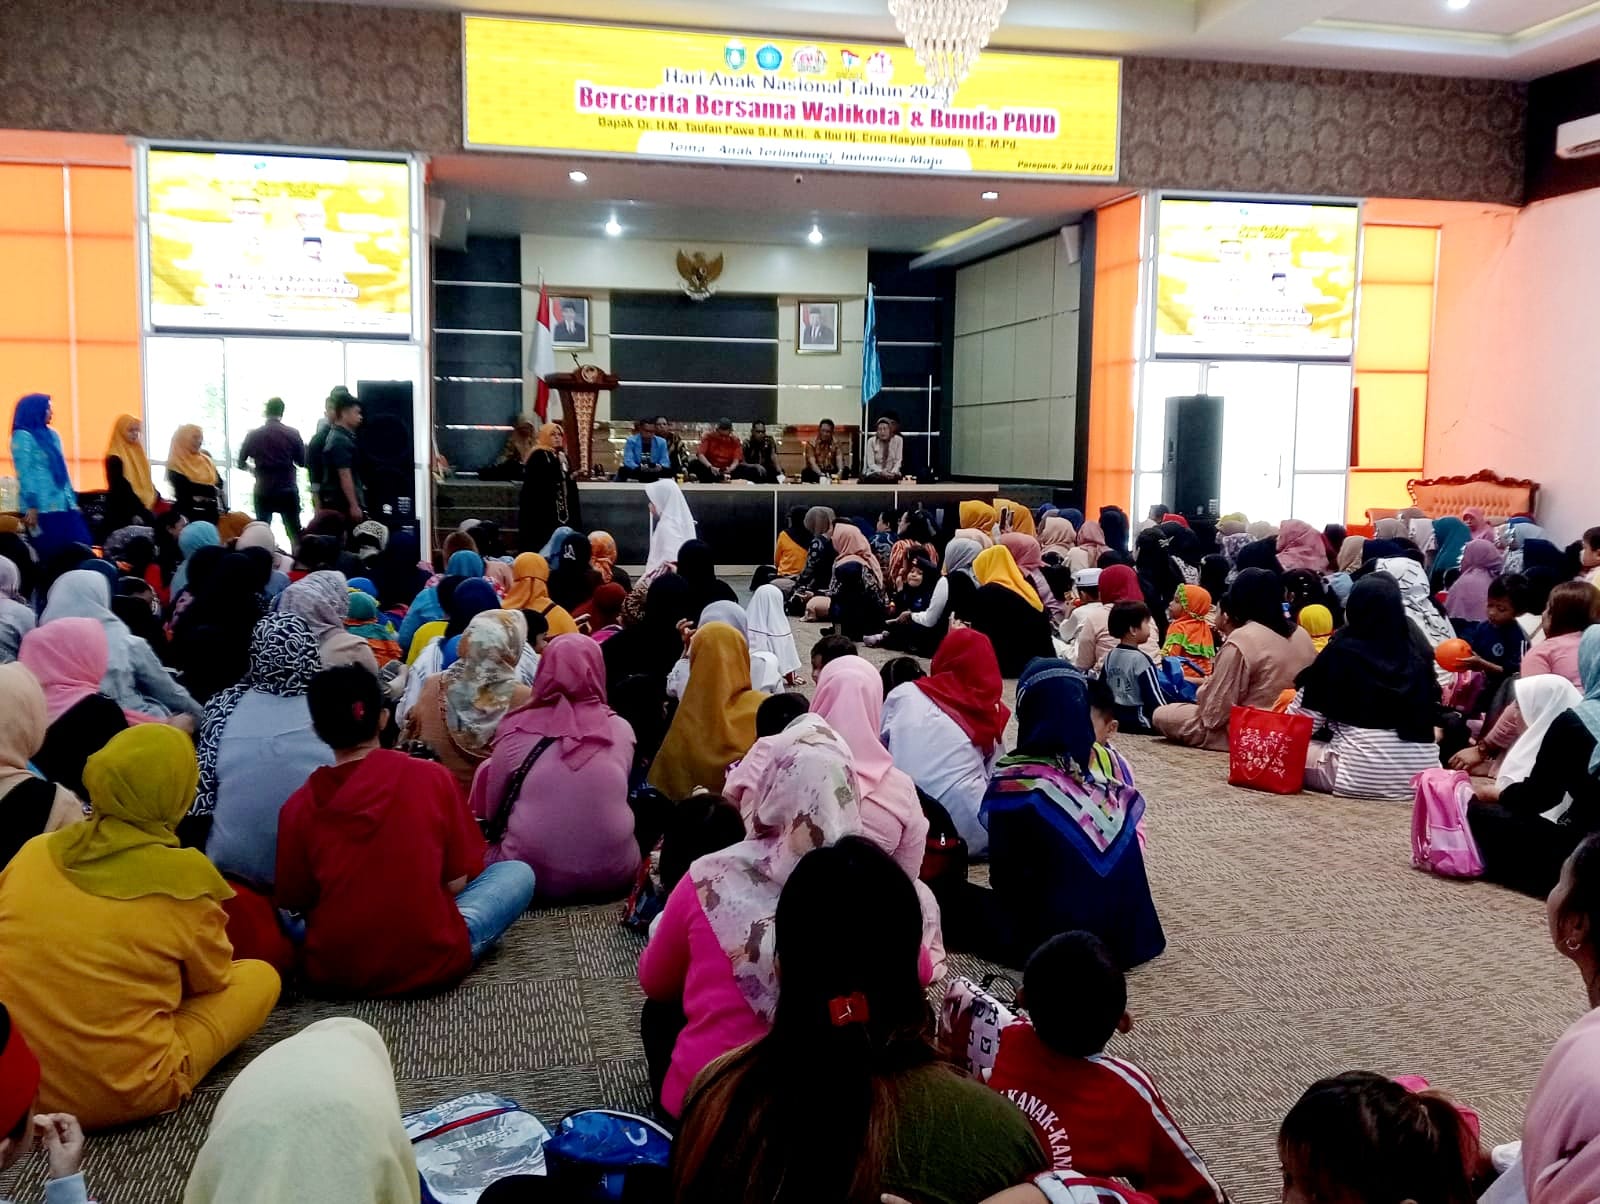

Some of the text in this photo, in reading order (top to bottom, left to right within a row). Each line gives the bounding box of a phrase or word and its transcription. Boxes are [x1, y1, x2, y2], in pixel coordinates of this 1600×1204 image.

[665, 67, 703, 84] Hari
[709, 71, 756, 88] Anak
[763, 74, 843, 94] Nasional
[849, 80, 903, 97] Tahun
[579, 85, 1056, 134] Bercerita Bersama Walikota & Bunda PAUD
[597, 115, 634, 130] Bapak
[930, 135, 965, 148] Taufan
[1007, 1088, 1073, 1170] KANAK-KAN
